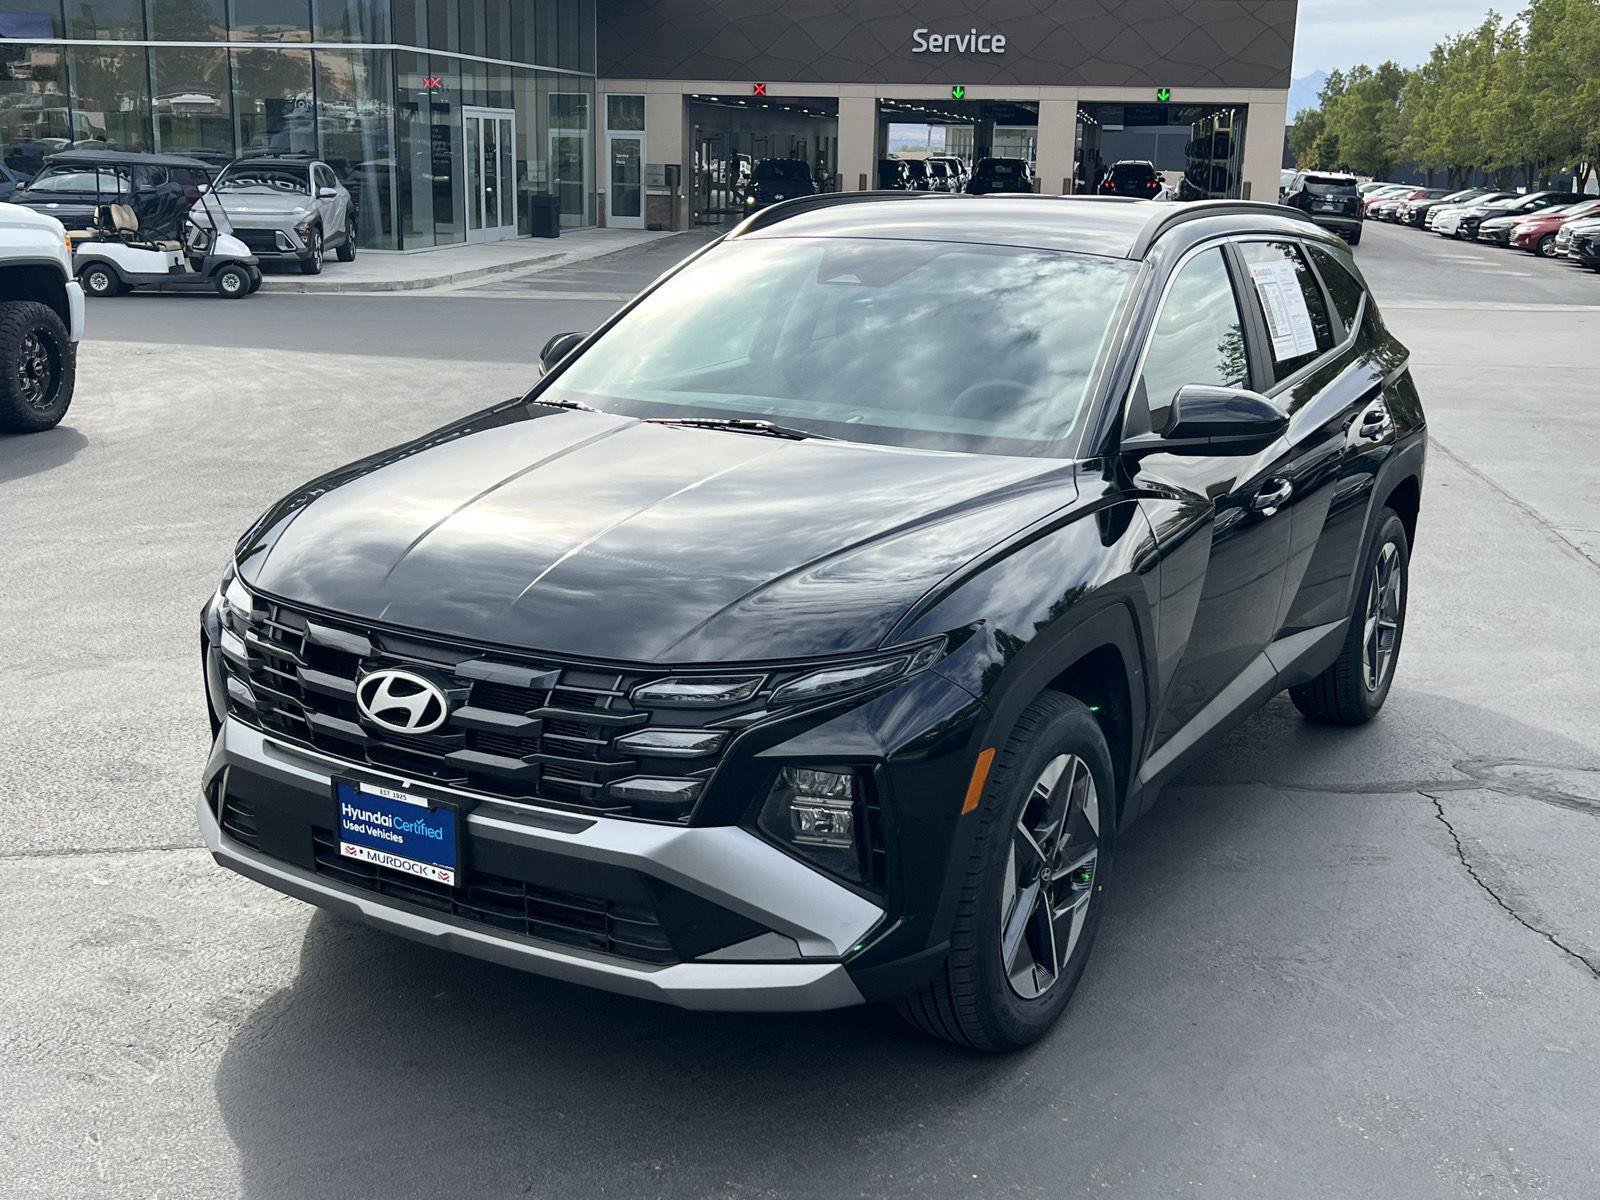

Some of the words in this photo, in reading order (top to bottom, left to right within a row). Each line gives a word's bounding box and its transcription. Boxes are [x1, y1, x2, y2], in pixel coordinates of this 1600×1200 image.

[911, 28, 1006, 53] Service
[393, 792, 407, 801] 1925
[341, 803, 392, 828] Hyundai
[393, 816, 443, 840] Certified
[343, 819, 365, 834] Used
[366, 825, 404, 843] Vehicles
[367, 850, 428, 876] MURDOCK
